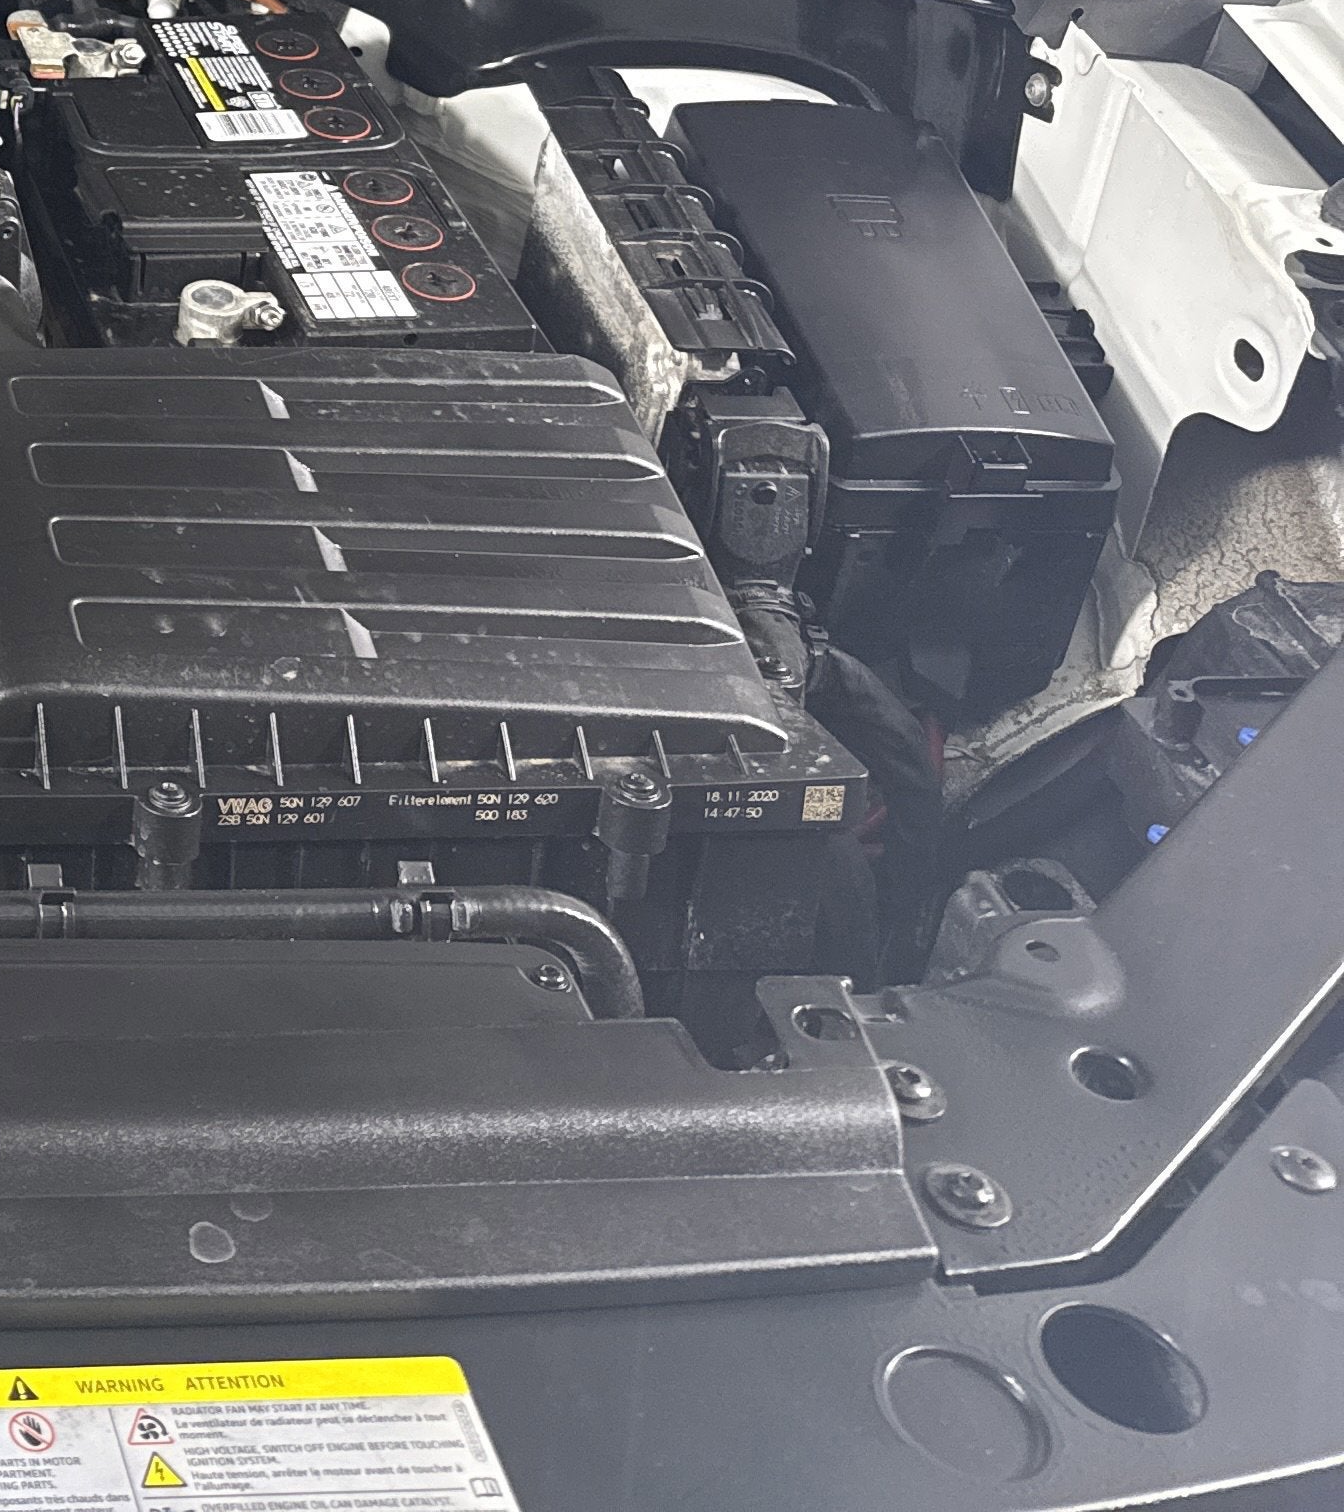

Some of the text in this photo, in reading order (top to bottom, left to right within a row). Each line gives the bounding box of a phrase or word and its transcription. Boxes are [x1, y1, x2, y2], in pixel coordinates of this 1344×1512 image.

[217, 798, 273, 814] VWAG
[311, 796, 332, 809] 129
[338, 795, 361, 807] 607
[388, 794, 472, 807] Filterelement
[508, 793, 530, 805] 129
[534, 793, 558, 805] 620
[217, 814, 241, 826] ZSB
[277, 813, 298, 824] 129
[303, 812, 325, 824] 601
[506, 809, 528, 821] 183
[75, 1375, 285, 1393] WARNING ATTENTION
[171, 1407, 223, 1415] RADIATOR
[226, 1406, 246, 1414] FAN
[248, 1405, 269, 1414] MAY
[272, 1404, 303, 1413] START
[305, 1403, 317, 1412] AT
[320, 1402, 340, 1411] ANY
[175, 1420, 188, 1429] Le
[190, 1419, 247, 1428] ventilateur
[250, 1418, 262, 1426] de
[265, 1417, 313, 1426] radiateur
[316, 1415, 341, 1427] peut
[356, 1414, 412, 1423] déclencher
[424, 1413, 446, 1422] tout
[184, 1440, 464, 1455] HIGH SWITCH OFF ENGINE BEFORE TOUCHING
[29, 1458, 40, 1467] IN
[42, 1456, 81, 1466] MOTOR
[188, 1457, 234, 1466] IGNITION
[192, 1470, 224, 1479] Haute
[323, 1467, 361, 1476] moteur
[364, 1466, 393, 1475] avant
[397, 1465, 410, 1474] de
[412, 1464, 452, 1473] toucher
[45, 1494, 65, 1503] très
[67, 1493, 104, 1503] chauds
[106, 1493, 130, 1502] dans
[267, 1500, 310, 1510] ENGINE
[312, 1499, 329, 1509] OIL
[330, 1498, 353, 1508] CAN
[354, 1497, 401, 1508] DAMAGE
